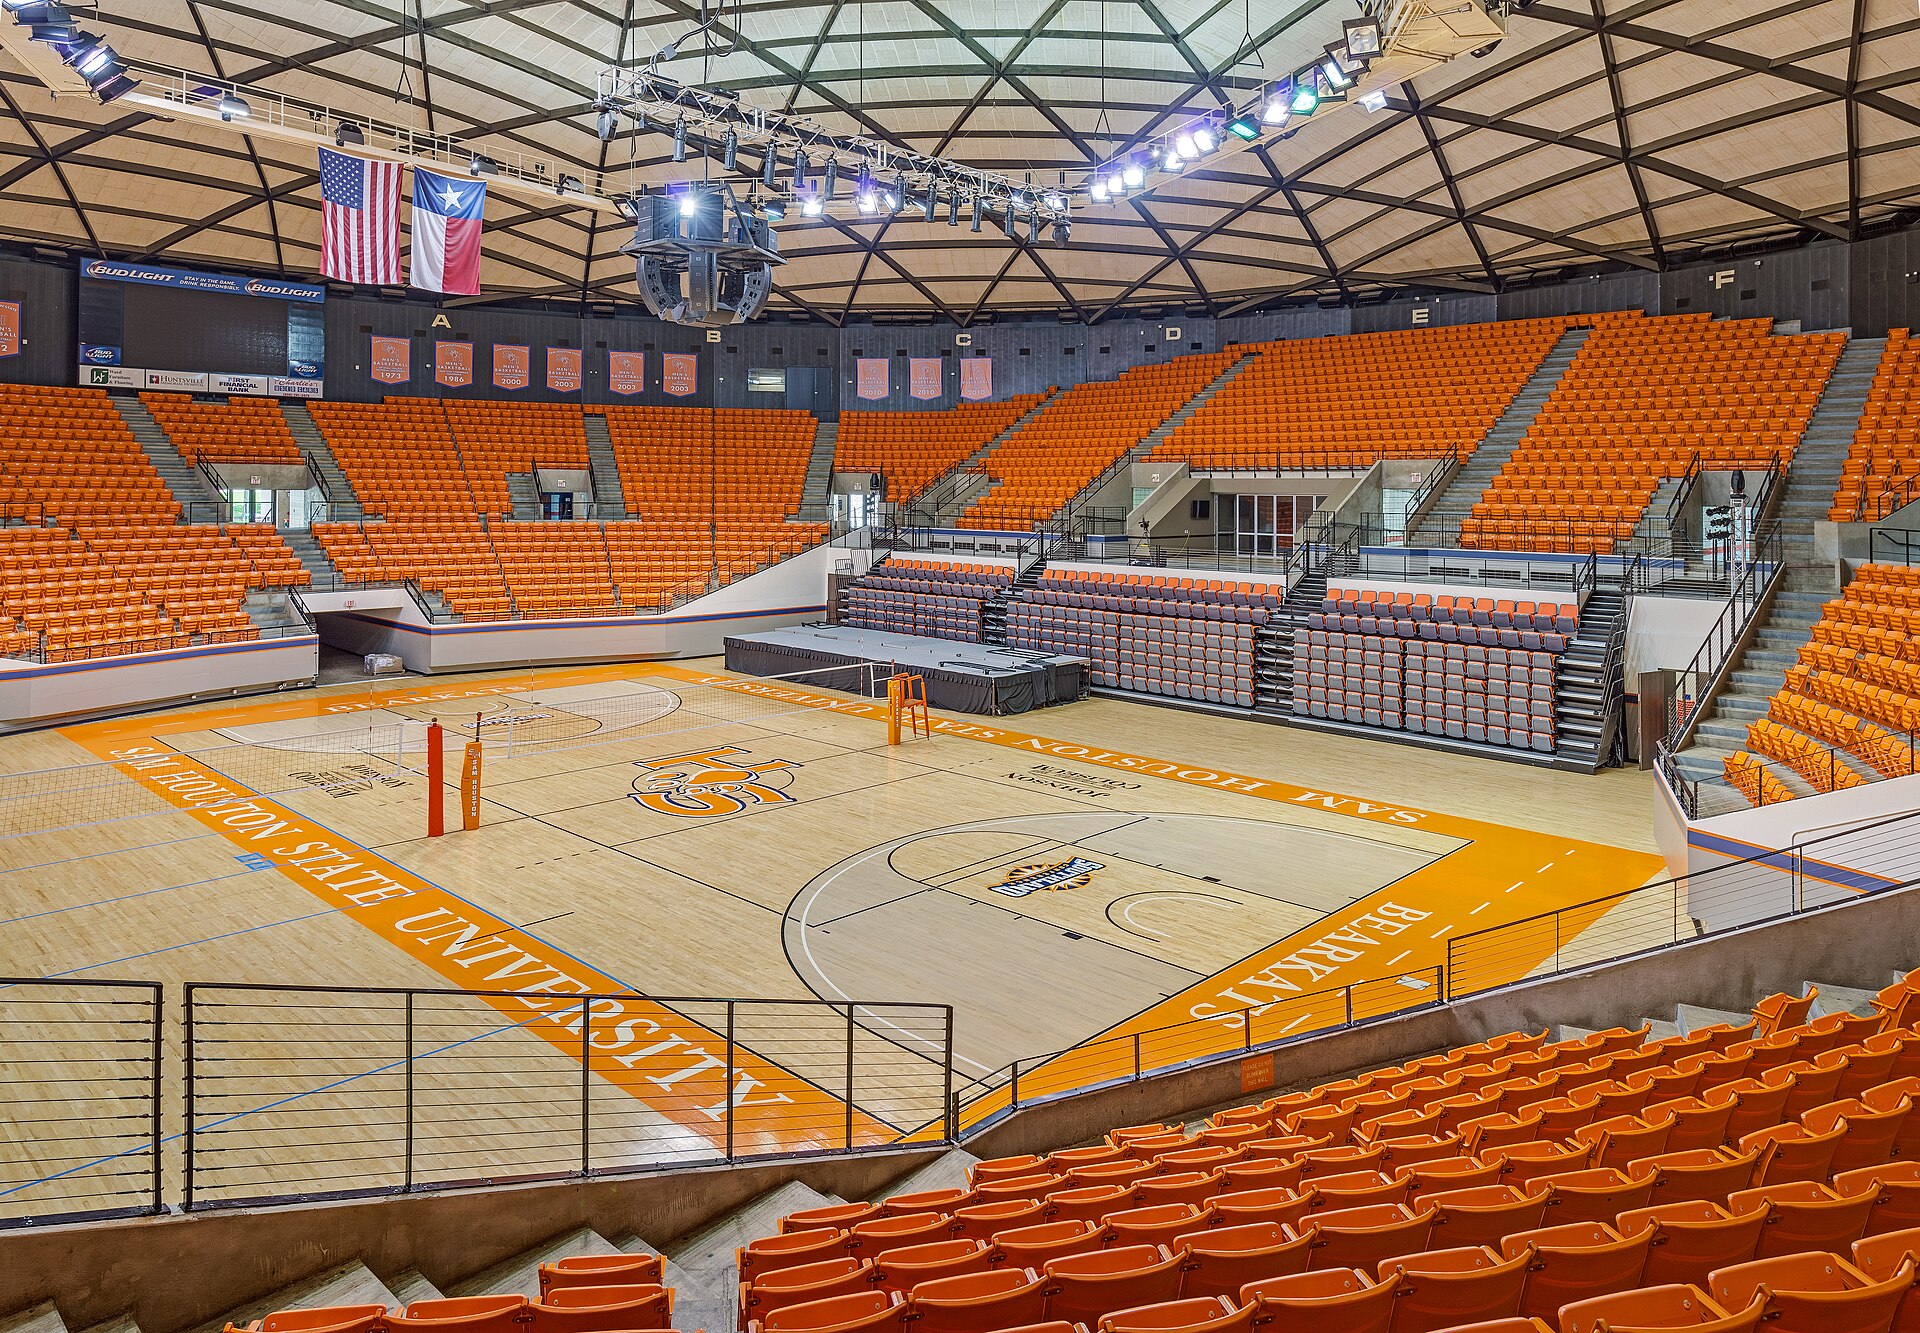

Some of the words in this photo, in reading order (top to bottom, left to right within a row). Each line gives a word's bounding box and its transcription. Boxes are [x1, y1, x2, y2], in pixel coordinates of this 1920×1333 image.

[94, 265, 129, 276] BUD
[129, 269, 175, 282] LIGHT
[1716, 270, 1735, 289] F
[251, 283, 281, 293] BUD
[280, 287, 320, 299] LIGHT
[431, 314, 452, 329] A
[1412, 309, 1429, 323] E
[707, 330, 721, 342] B
[956, 333, 971, 346] C
[1166, 328, 1181, 340] D
[324, 686, 527, 712] BEARKATS
[1000, 772, 1111, 797] JOHNSON
[1012, 738, 1272, 792] HOUSTON
[1289, 791, 1428, 823] SAM
[989, 857, 1104, 898] SOUTHLAND
[109, 745, 181, 771] SAM
[149, 769, 303, 841] HOUSTON
[272, 841, 417, 908] STATE
[394, 906, 795, 1122] UNIVERSITY
[1188, 901, 1434, 1030] BEARKATS
